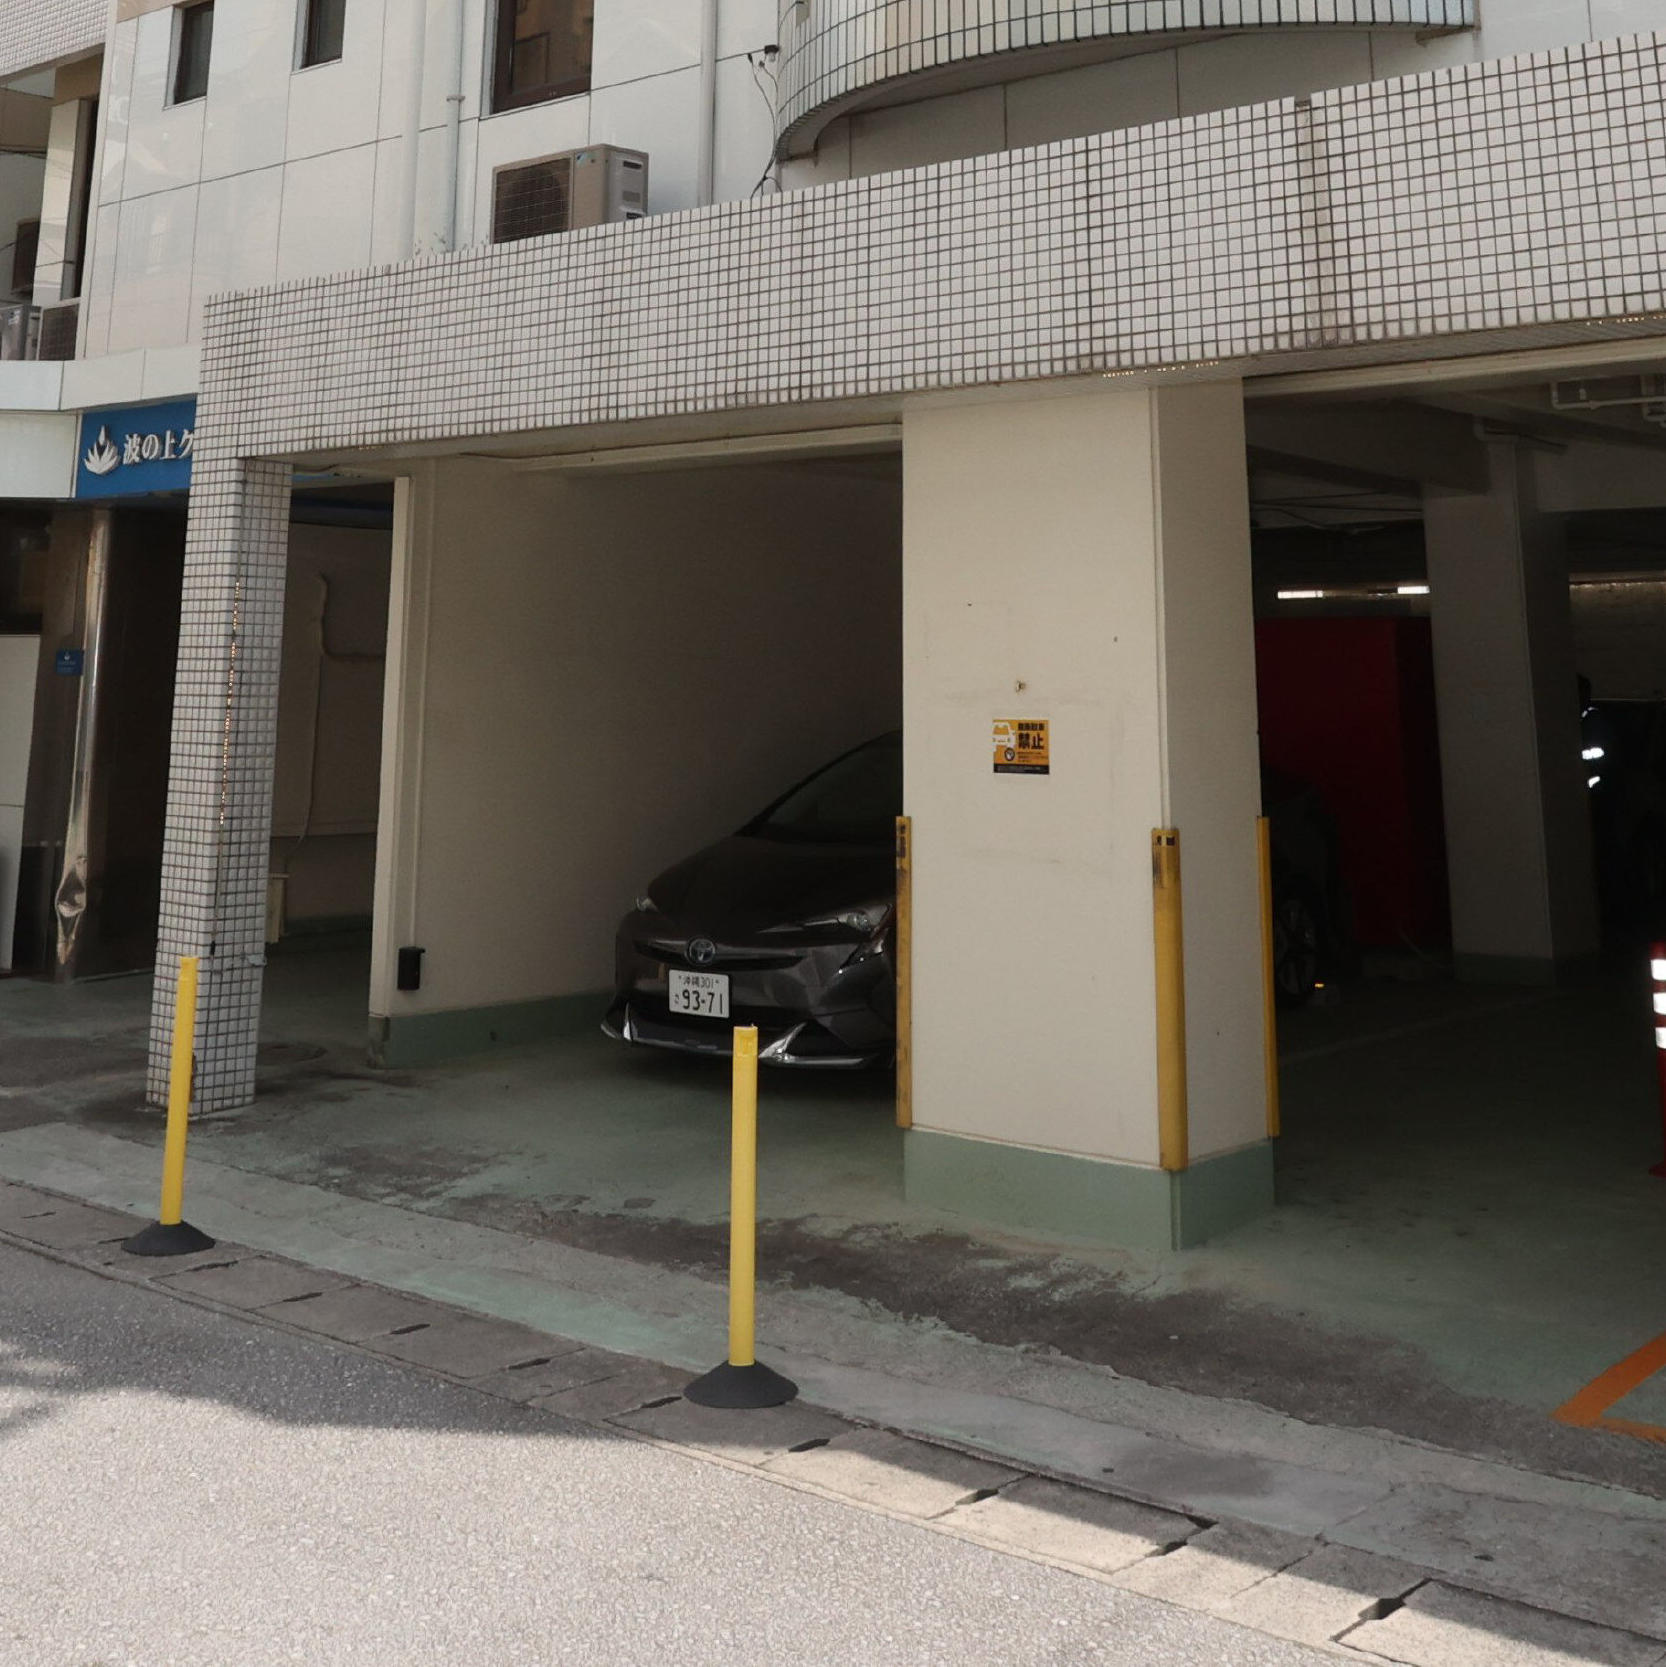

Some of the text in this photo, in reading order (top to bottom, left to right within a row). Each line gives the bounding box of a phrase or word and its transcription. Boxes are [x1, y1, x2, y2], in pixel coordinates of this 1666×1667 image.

[123, 429, 194, 465] 波の上ク
[1018, 732, 1045, 750] 禁止
[682, 988, 723, 1015] 93-71
